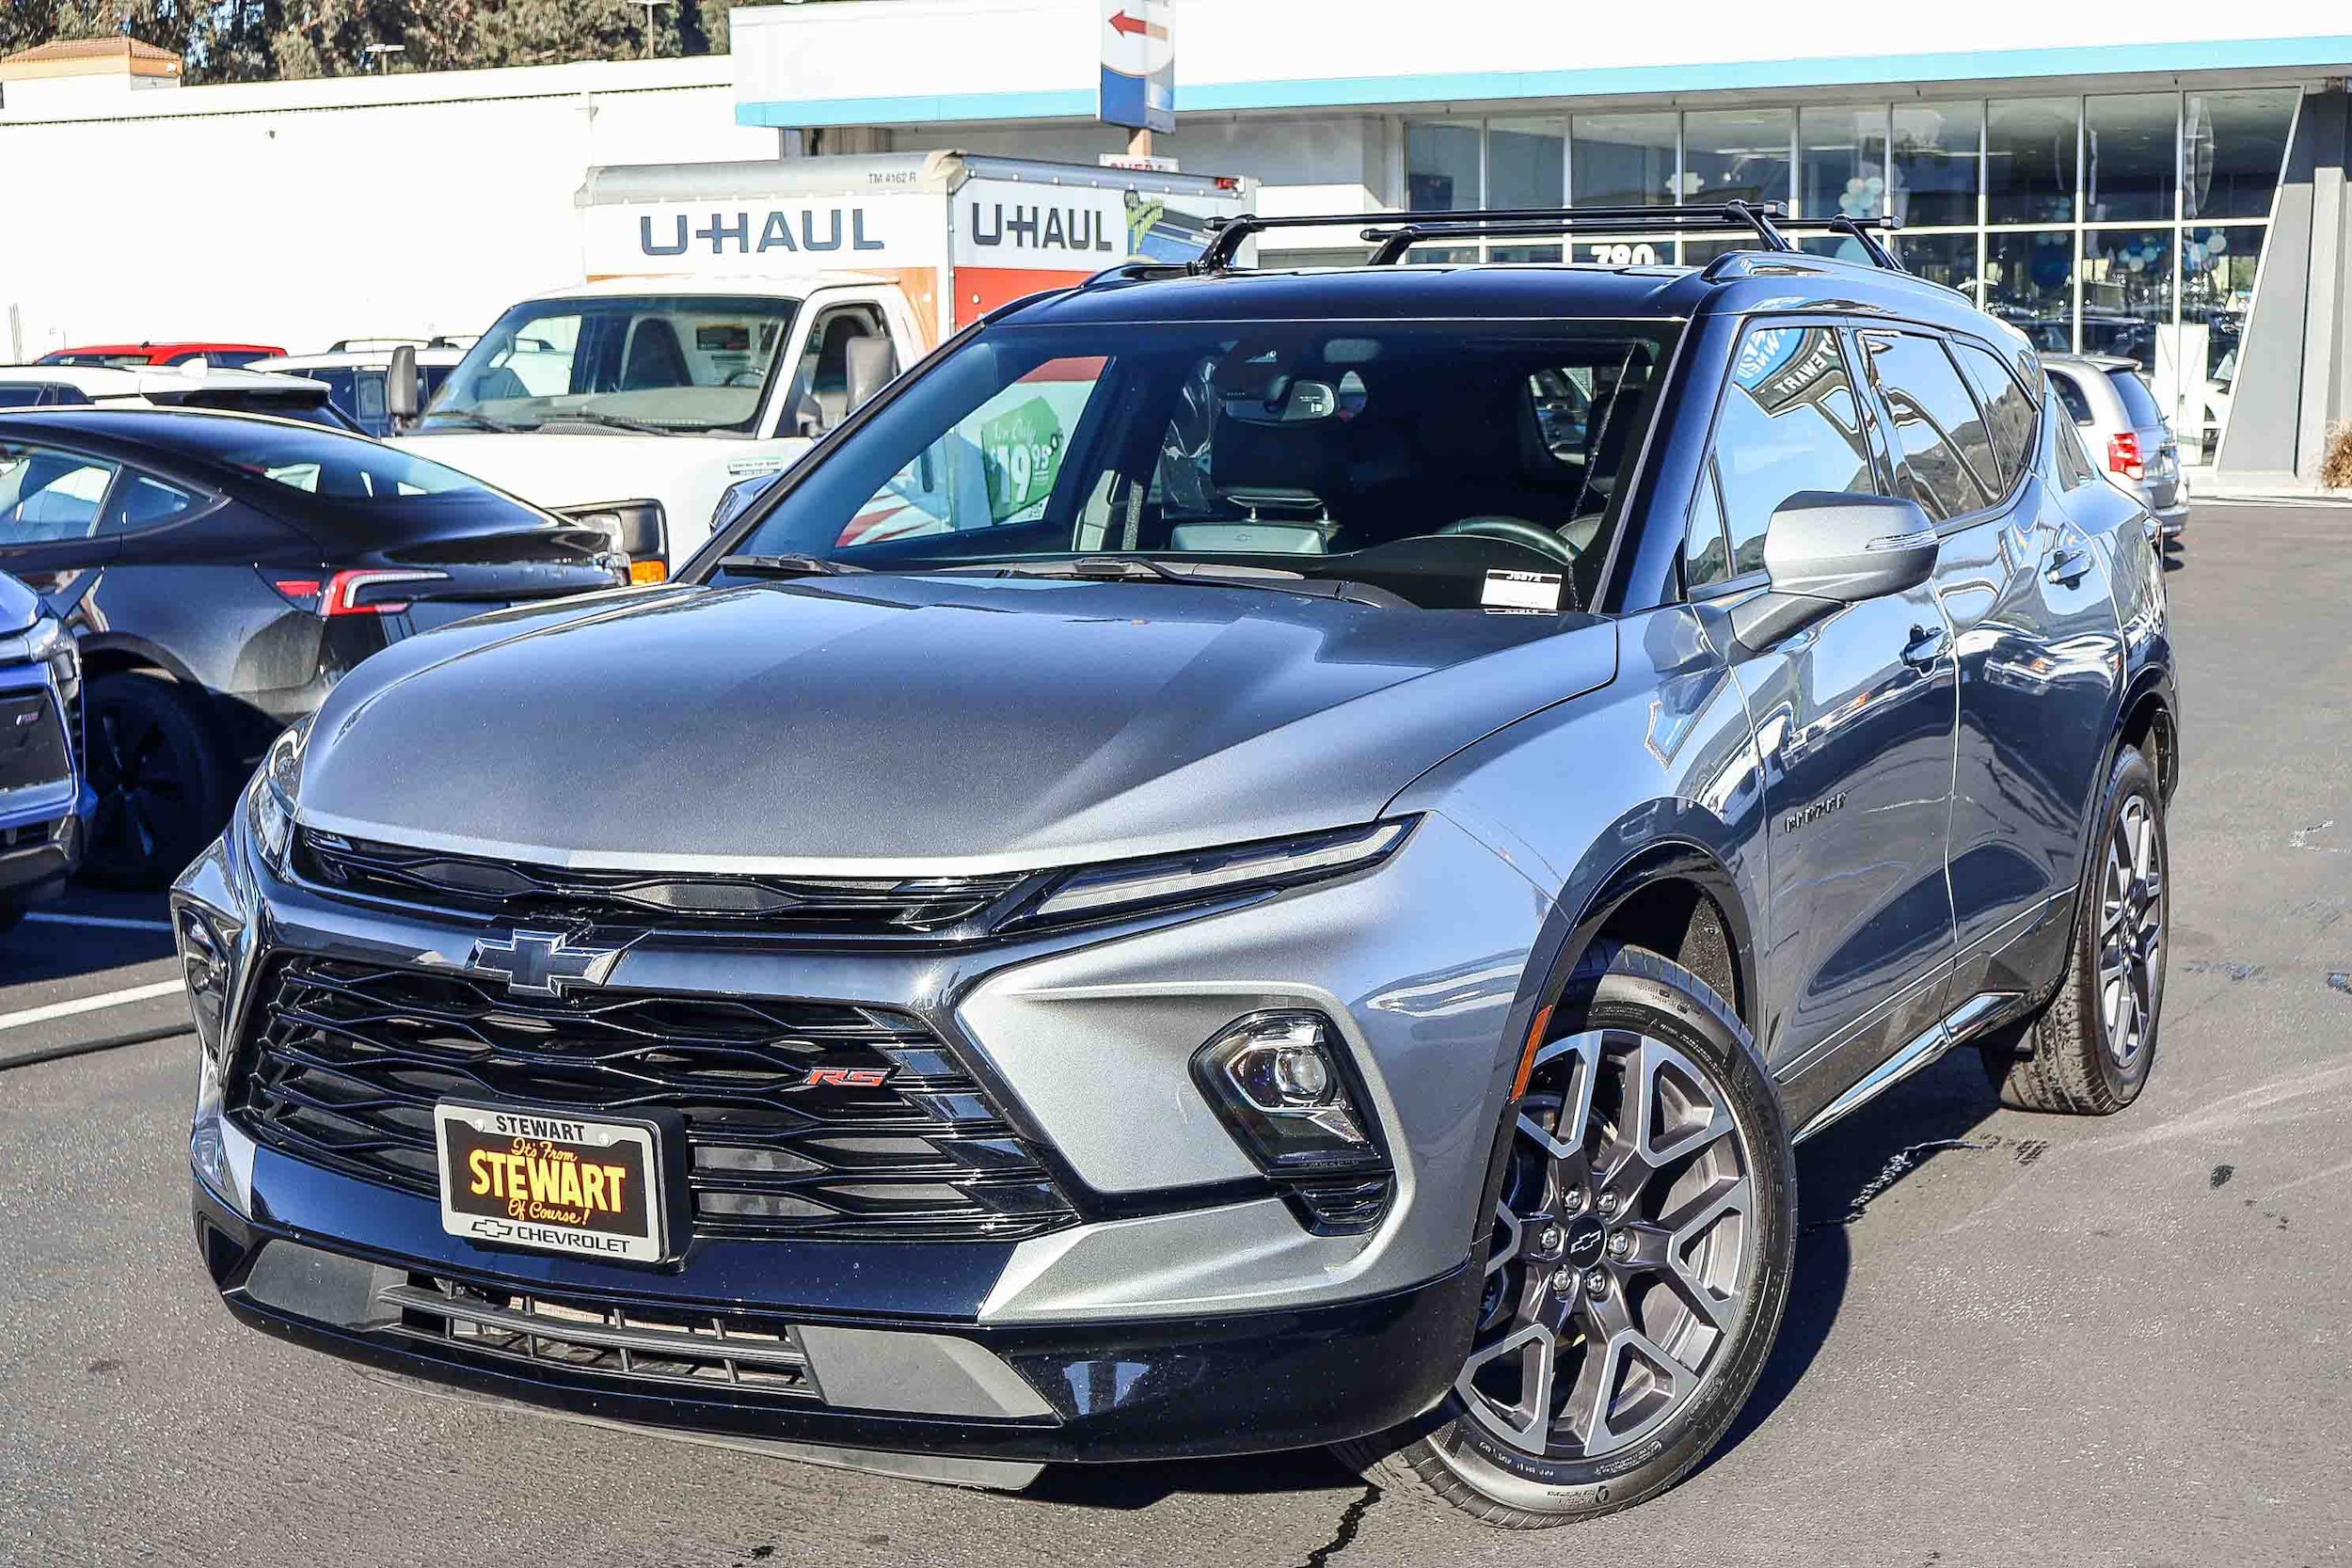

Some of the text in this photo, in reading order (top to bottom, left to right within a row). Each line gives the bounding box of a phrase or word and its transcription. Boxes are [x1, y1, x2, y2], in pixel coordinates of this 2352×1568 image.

[803, 1068, 888, 1087] RS
[496, 1115, 584, 1141] STEWART
[511, 1137, 578, 1163] It's From
[469, 1148, 627, 1213] STEWART
[508, 1197, 526, 1222] Of
[516, 1226, 630, 1254] CHEVROLET
